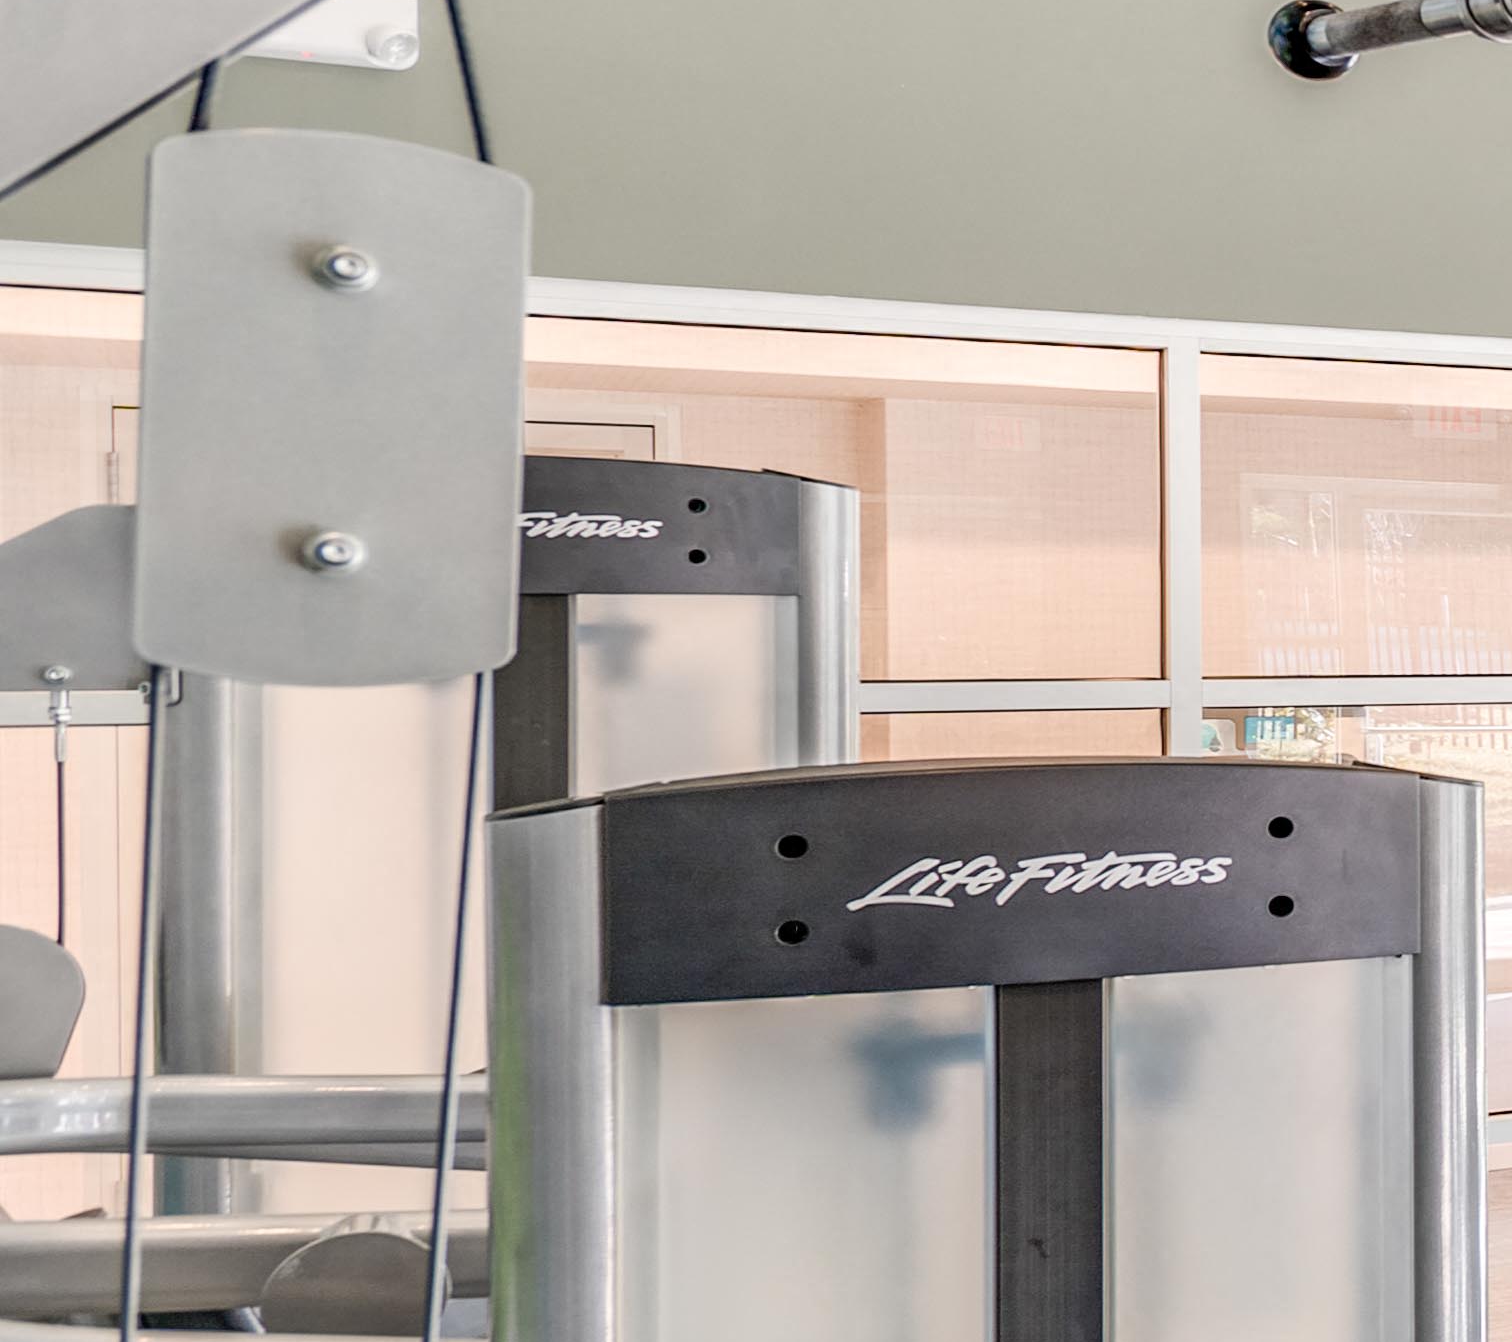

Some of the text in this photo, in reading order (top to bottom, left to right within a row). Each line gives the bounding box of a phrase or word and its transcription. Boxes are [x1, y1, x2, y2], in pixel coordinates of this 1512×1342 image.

[516, 512, 664, 539] Fitness
[846, 851, 1232, 912] Life Fitness
